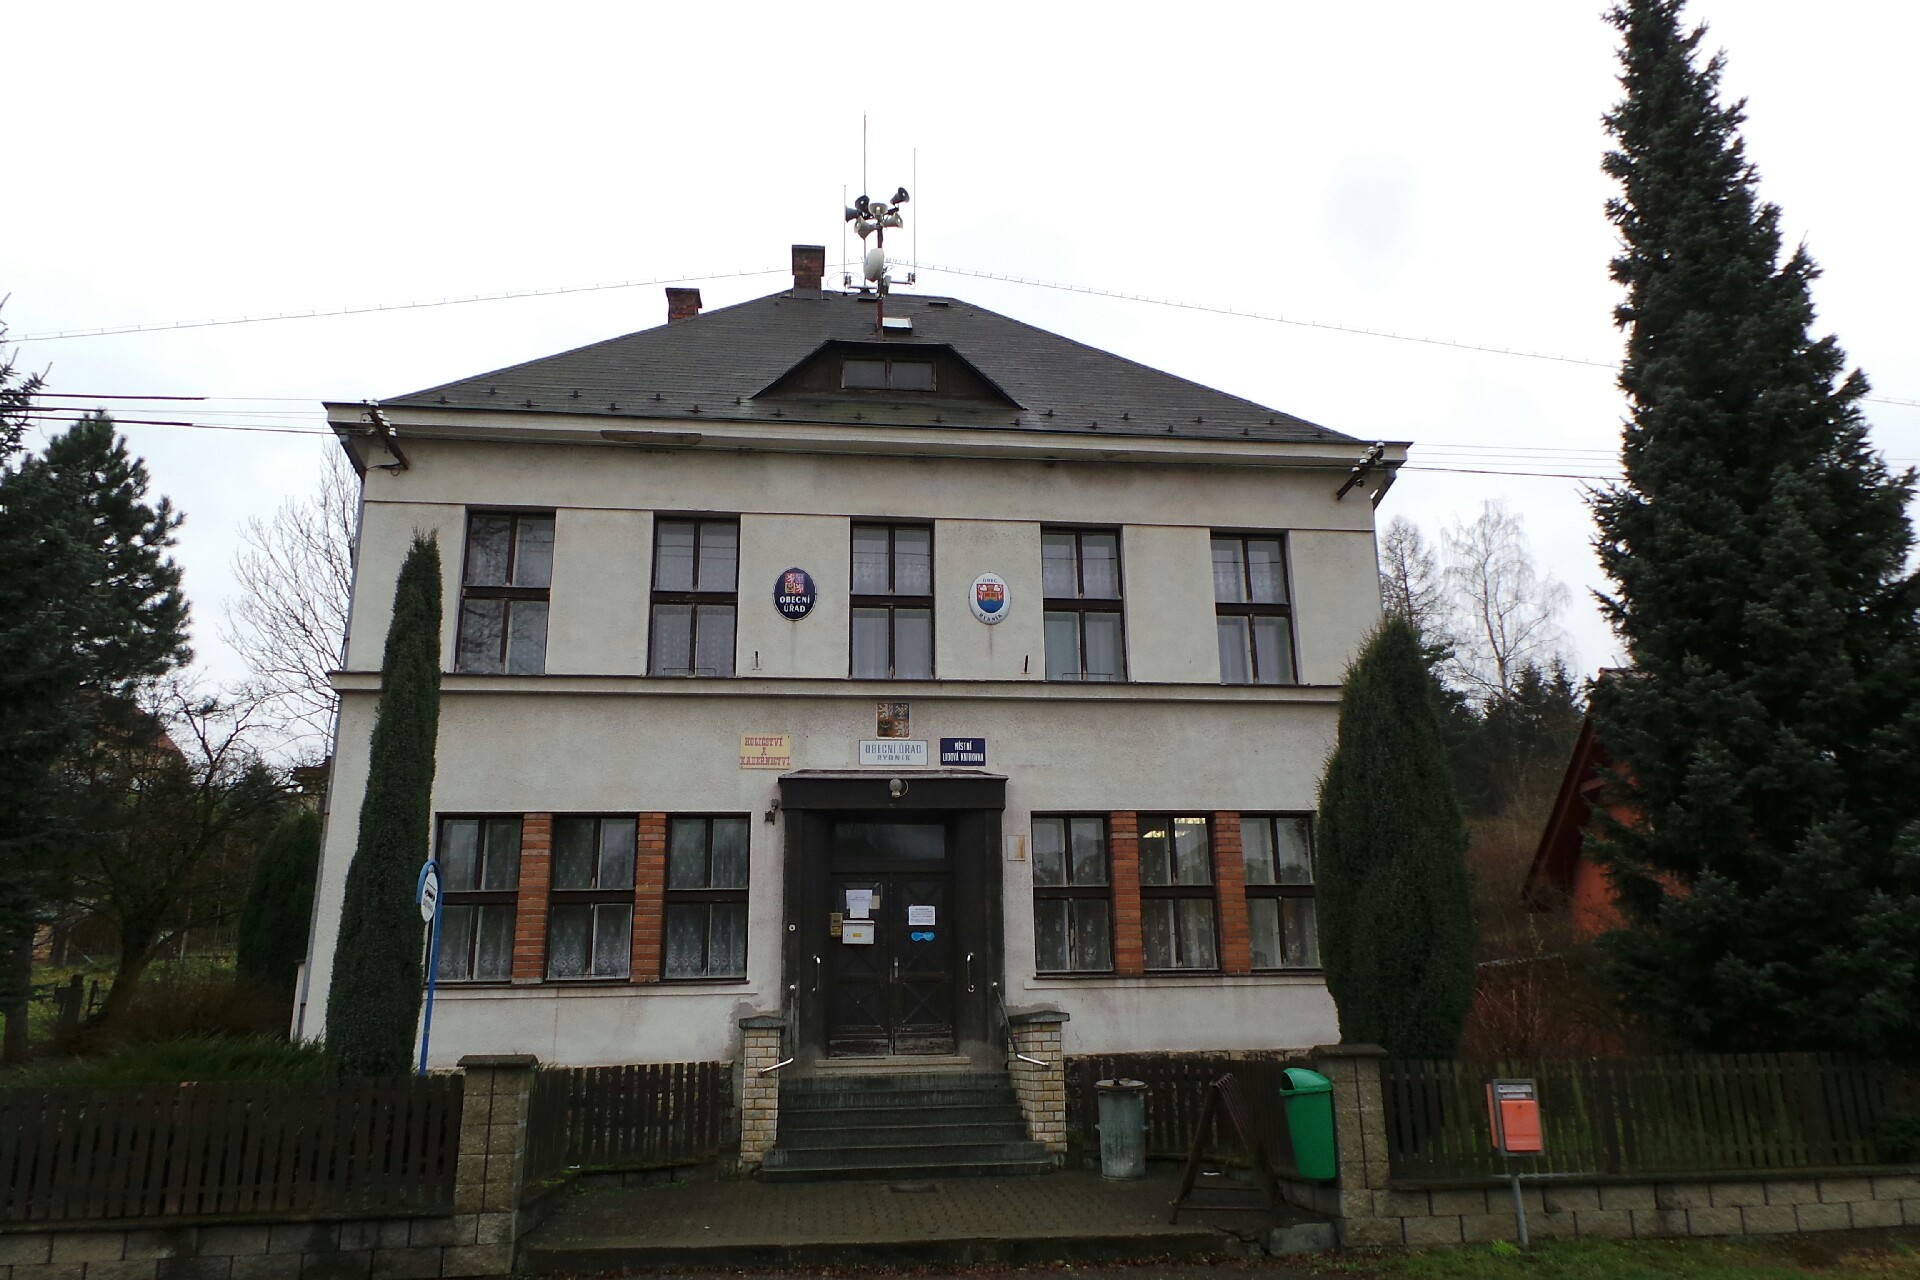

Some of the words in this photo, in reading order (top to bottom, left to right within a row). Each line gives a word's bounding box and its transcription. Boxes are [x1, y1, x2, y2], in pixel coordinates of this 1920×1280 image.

[779, 595, 810, 604] OBECNÍ
[783, 603, 806, 612] ÚŘAD
[865, 743, 896, 754] OBECNÍ
[898, 742, 922, 754] ÚŘAD
